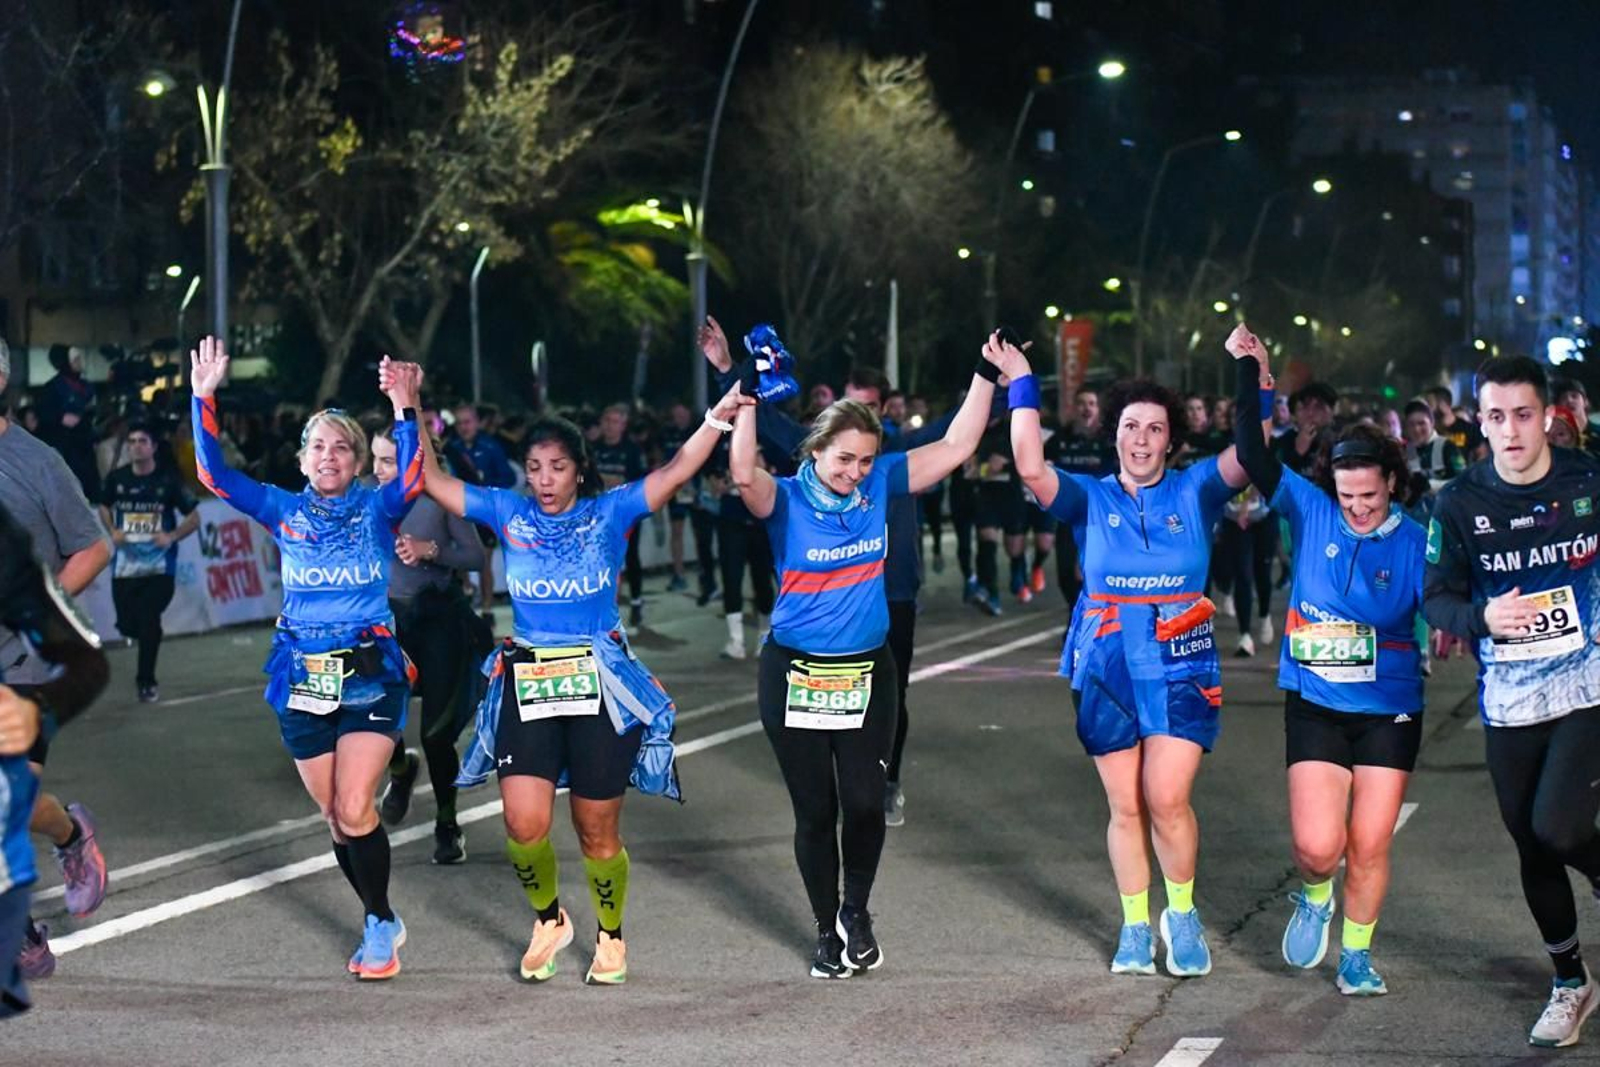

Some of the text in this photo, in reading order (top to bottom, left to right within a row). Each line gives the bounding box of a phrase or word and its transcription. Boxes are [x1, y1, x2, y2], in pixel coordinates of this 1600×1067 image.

[806, 537, 882, 561] enerplus
[1480, 551, 1521, 572] SAN
[1528, 533, 1598, 568] ANTÓN
[1106, 574, 1186, 591] enerplus
[1526, 608, 1569, 634] 99
[1171, 637, 1212, 657] Lucena
[1299, 638, 1369, 660] 1284
[522, 674, 593, 700] 2143
[796, 688, 863, 710] 1968
